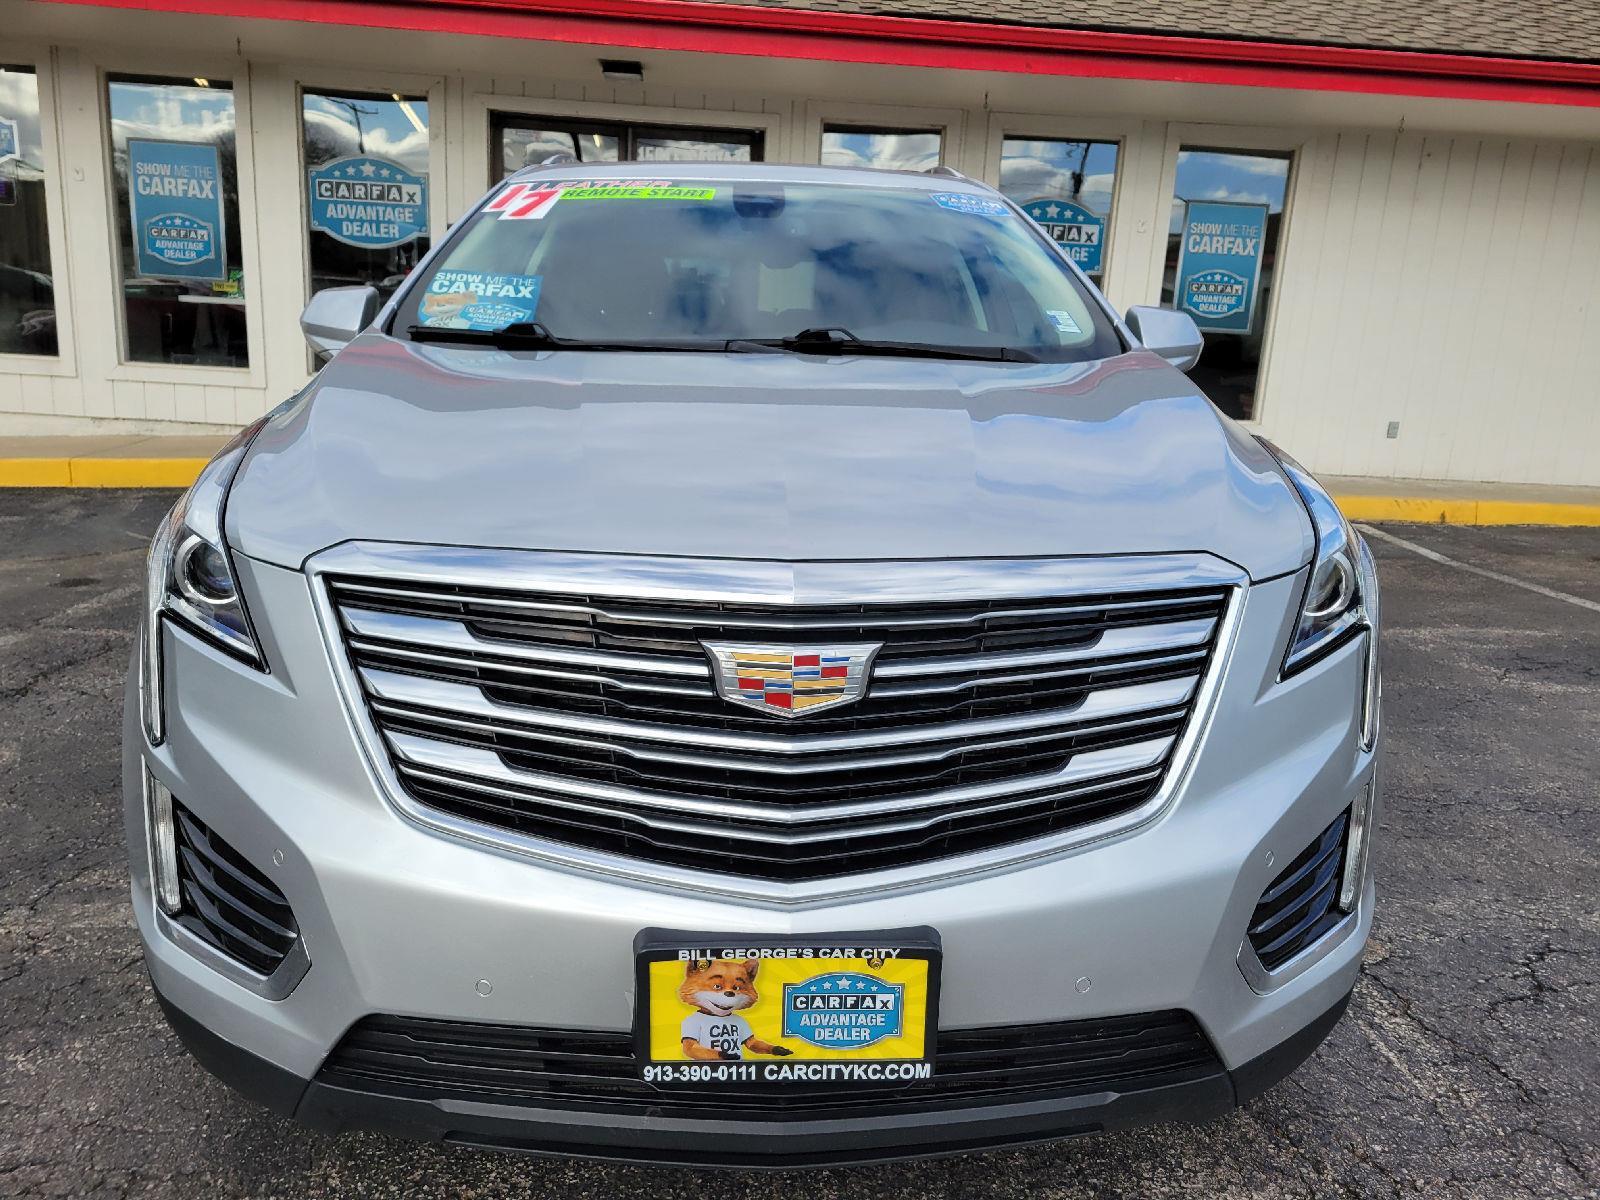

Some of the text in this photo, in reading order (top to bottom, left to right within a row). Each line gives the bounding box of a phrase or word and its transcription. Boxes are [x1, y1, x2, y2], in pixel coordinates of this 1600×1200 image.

[136, 162, 213, 180] SHOW ME THE
[137, 175, 215, 200] CARFAX
[320, 182, 418, 204] CARFAX
[562, 188, 707, 197] REMOTE START
[326, 203, 414, 223] ADVANTAGE
[151, 228, 208, 240] CARFAX
[342, 221, 399, 239] DEALER
[1190, 222, 1259, 237] SHOW ME THE
[155, 240, 205, 251] ADVANTAGE
[1188, 235, 1256, 257] CARFAX
[164, 249, 197, 259] DEALER
[435, 272, 536, 288] SHOW ME THE
[432, 280, 535, 299] CARFAX
[1191, 283, 1241, 295] CARFAX
[1192, 294, 1238, 305] ADVANTAGE
[1199, 303, 1228, 313] DEALER
[678, 948, 901, 960] BILL GEORGE'S CAR CITY
[795, 994, 894, 1011] CARFAX
[800, 1013, 886, 1027] ADVANTAGE
[709, 1024, 739, 1038] CAR
[814, 1027, 871, 1041] DEALER
[710, 1038, 741, 1052] FOX
[643, 1063, 931, 1082] 913-390-0111 CARCITYKC.COM
